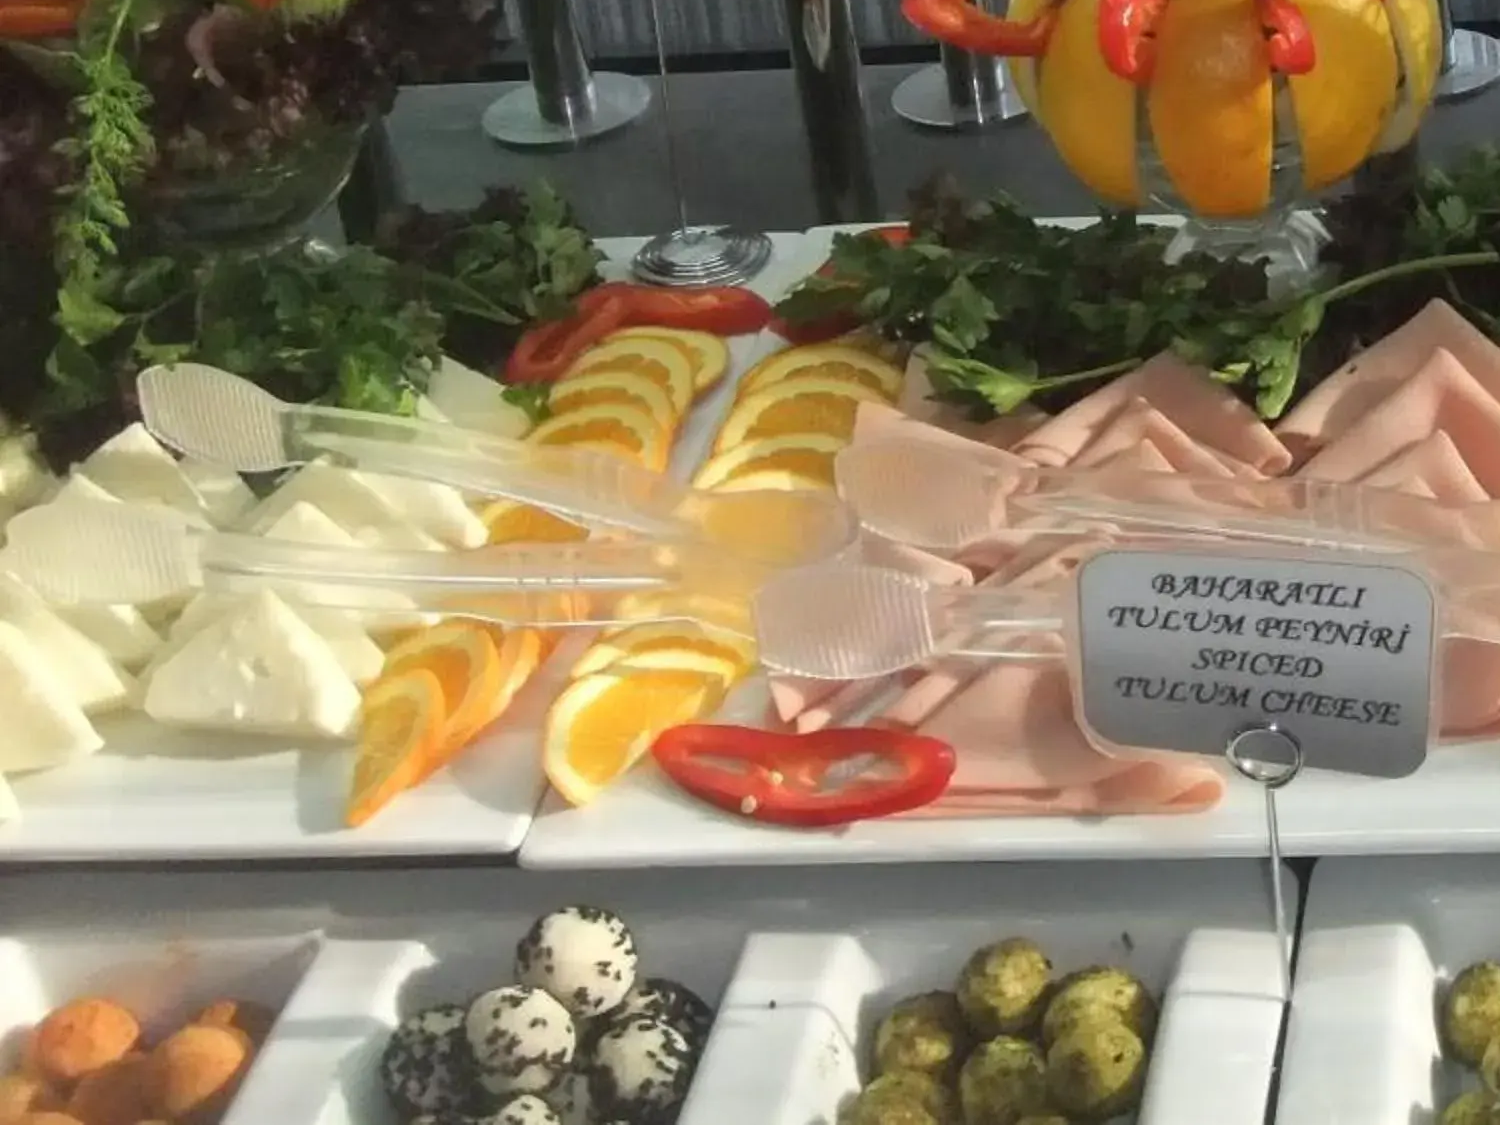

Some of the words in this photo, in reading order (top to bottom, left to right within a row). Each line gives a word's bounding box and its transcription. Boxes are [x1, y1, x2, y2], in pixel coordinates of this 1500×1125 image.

[1151, 572, 1366, 608] BAHARATLI
[1108, 604, 1244, 637] TULUM
[1255, 614, 1411, 654] PEYNİRİ
[1191, 646, 1323, 678] SPICED
[1115, 675, 1250, 708] TULUM
[1259, 688, 1401, 726] CHEESE
